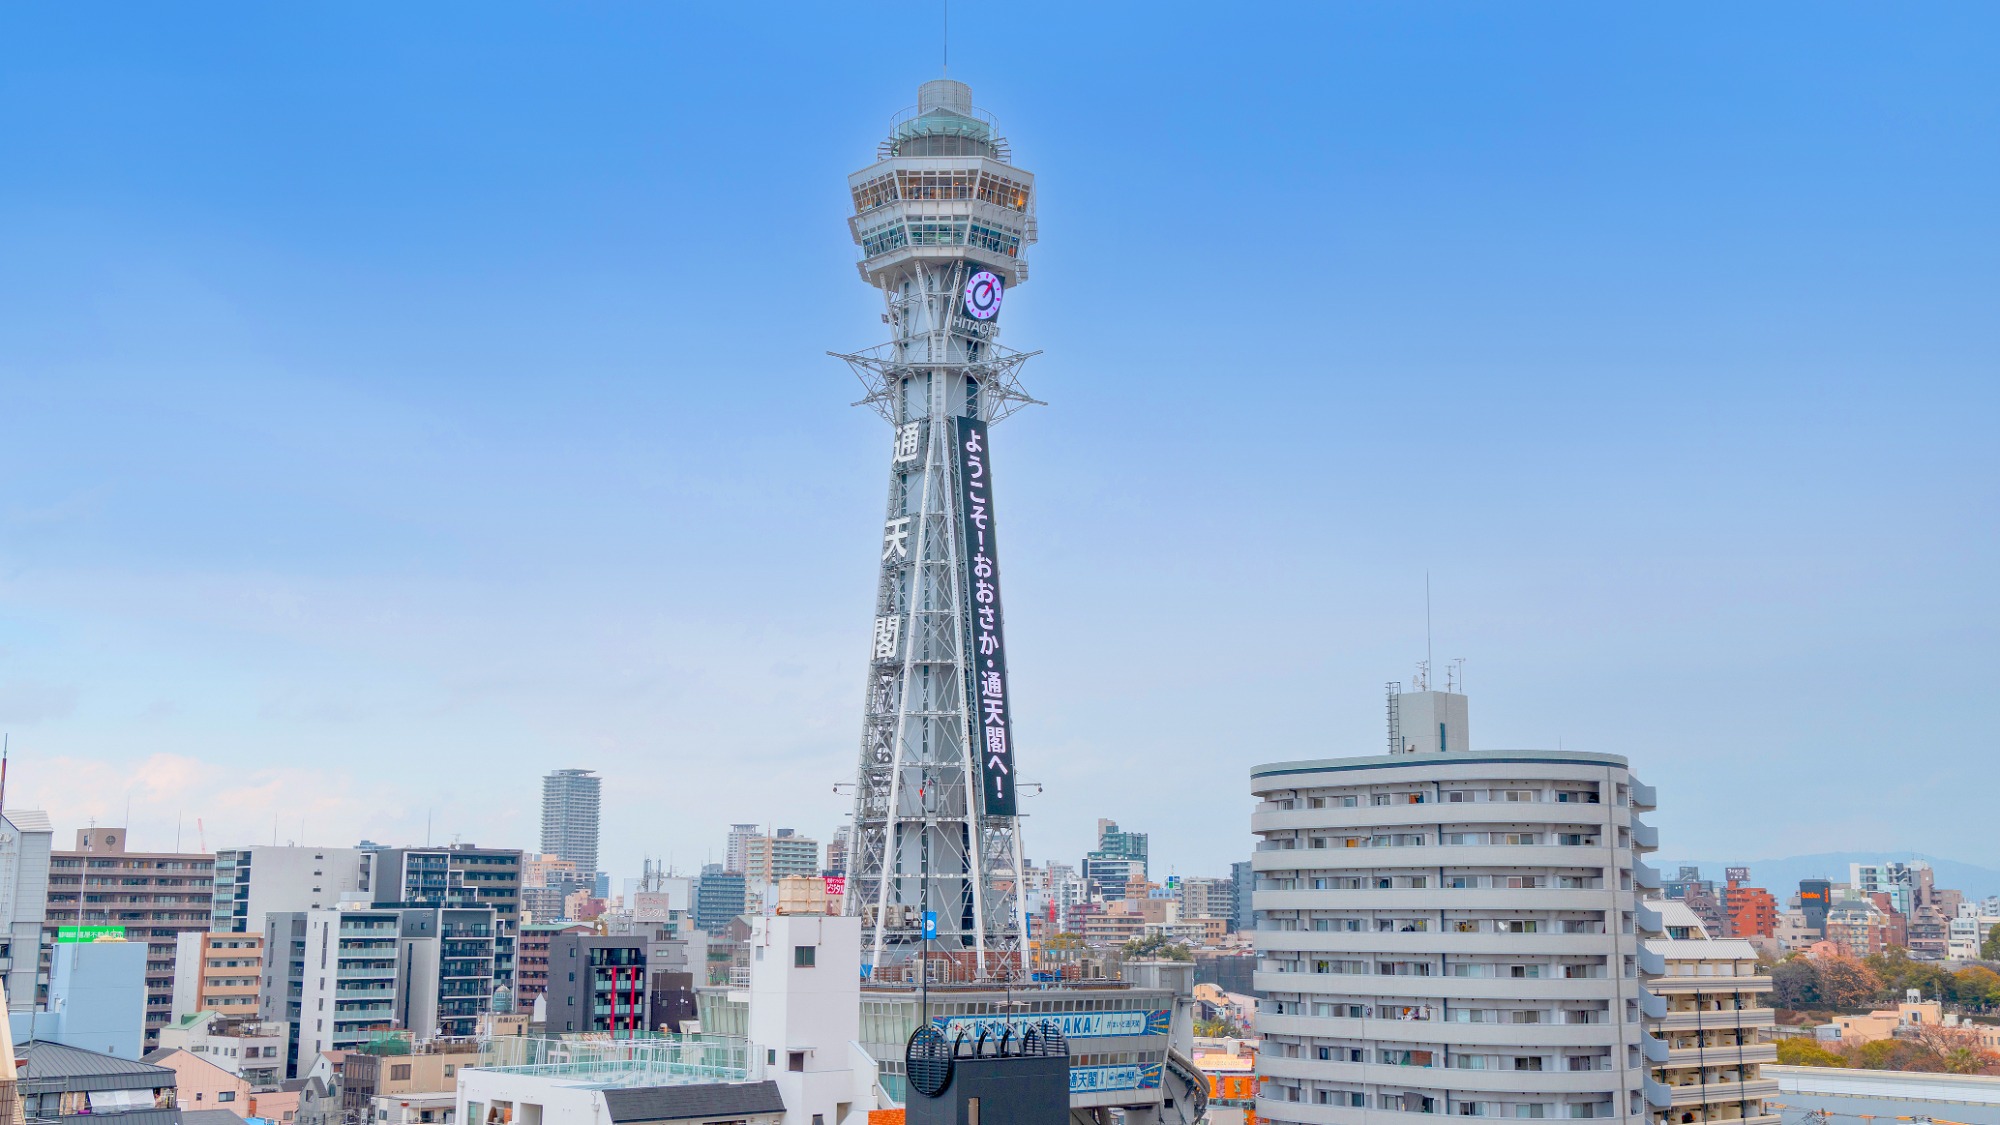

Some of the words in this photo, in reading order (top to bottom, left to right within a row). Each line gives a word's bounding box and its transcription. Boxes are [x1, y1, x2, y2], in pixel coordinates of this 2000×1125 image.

[952, 316, 1000, 338] HITACHI
[871, 420, 919, 660] 通天閣
